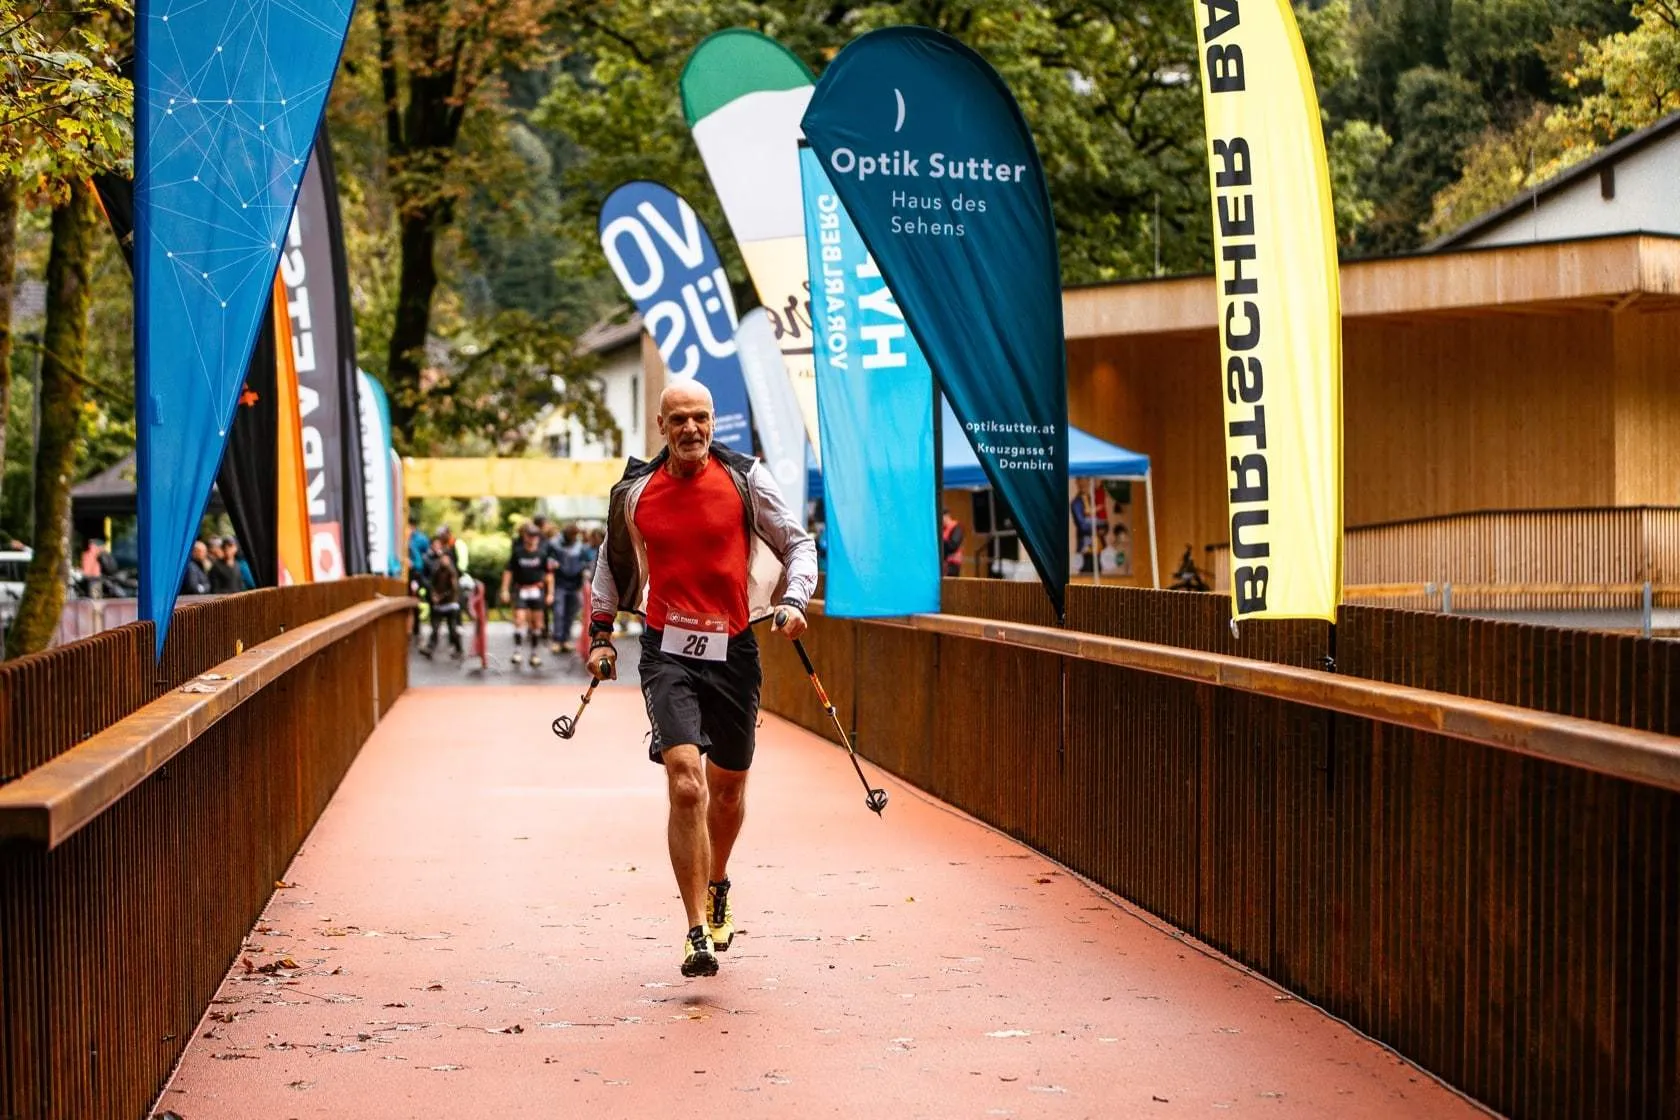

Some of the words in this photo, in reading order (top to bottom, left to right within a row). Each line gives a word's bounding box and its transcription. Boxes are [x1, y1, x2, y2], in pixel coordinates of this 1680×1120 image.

[831, 147, 919, 181] Optik
[929, 153, 1026, 183] Sutter
[891, 190, 941, 210] Haus
[951, 194, 987, 212] des
[891, 216, 965, 236] Sehens
[966, 420, 1055, 434] optiksutter.at
[977, 443, 1044, 457] Kreuzgasse
[1047, 446, 1054, 456] 1
[1000, 458, 1054, 471] Dornbirn
[682, 635, 708, 656] 26
